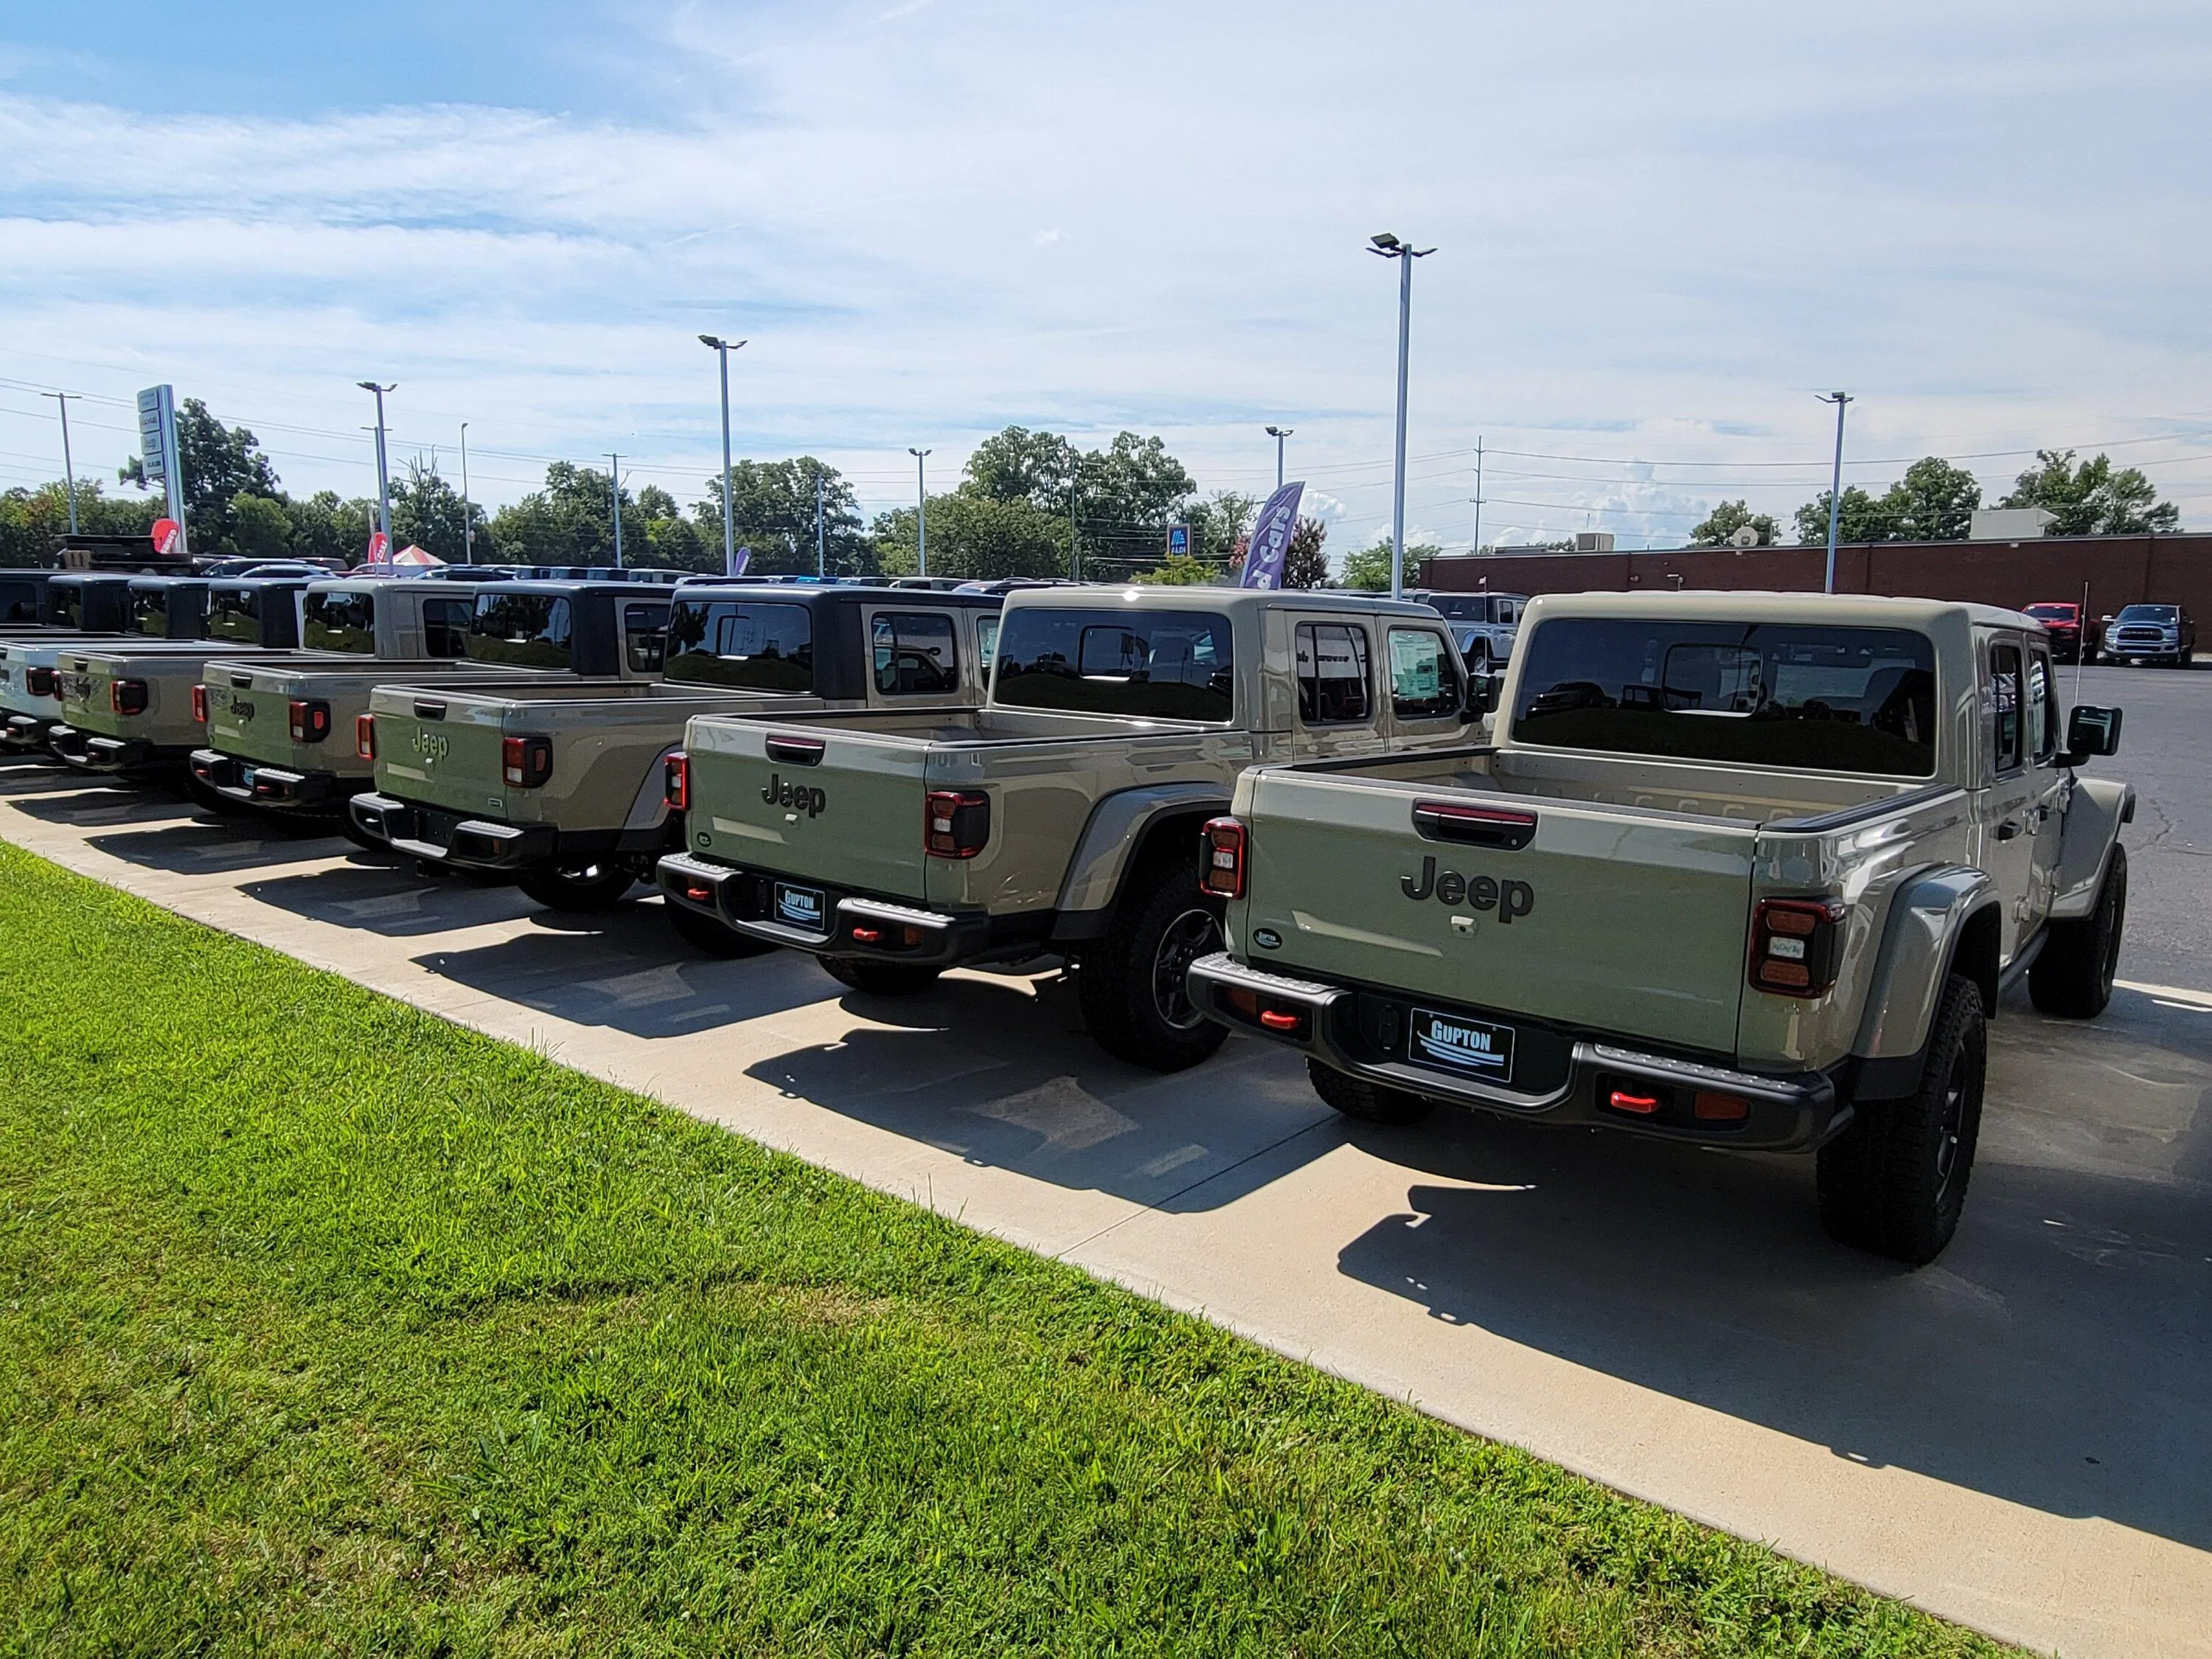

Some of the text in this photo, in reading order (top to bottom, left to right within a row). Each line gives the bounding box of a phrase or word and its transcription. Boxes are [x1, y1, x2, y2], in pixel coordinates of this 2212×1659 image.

[411, 726, 449, 761] Jeep
[761, 773, 826, 818] Jeep
[785, 889, 814, 910] GUPTON
[1401, 856, 1534, 924] Jeep
[1430, 1020, 1492, 1052] GUPTON
